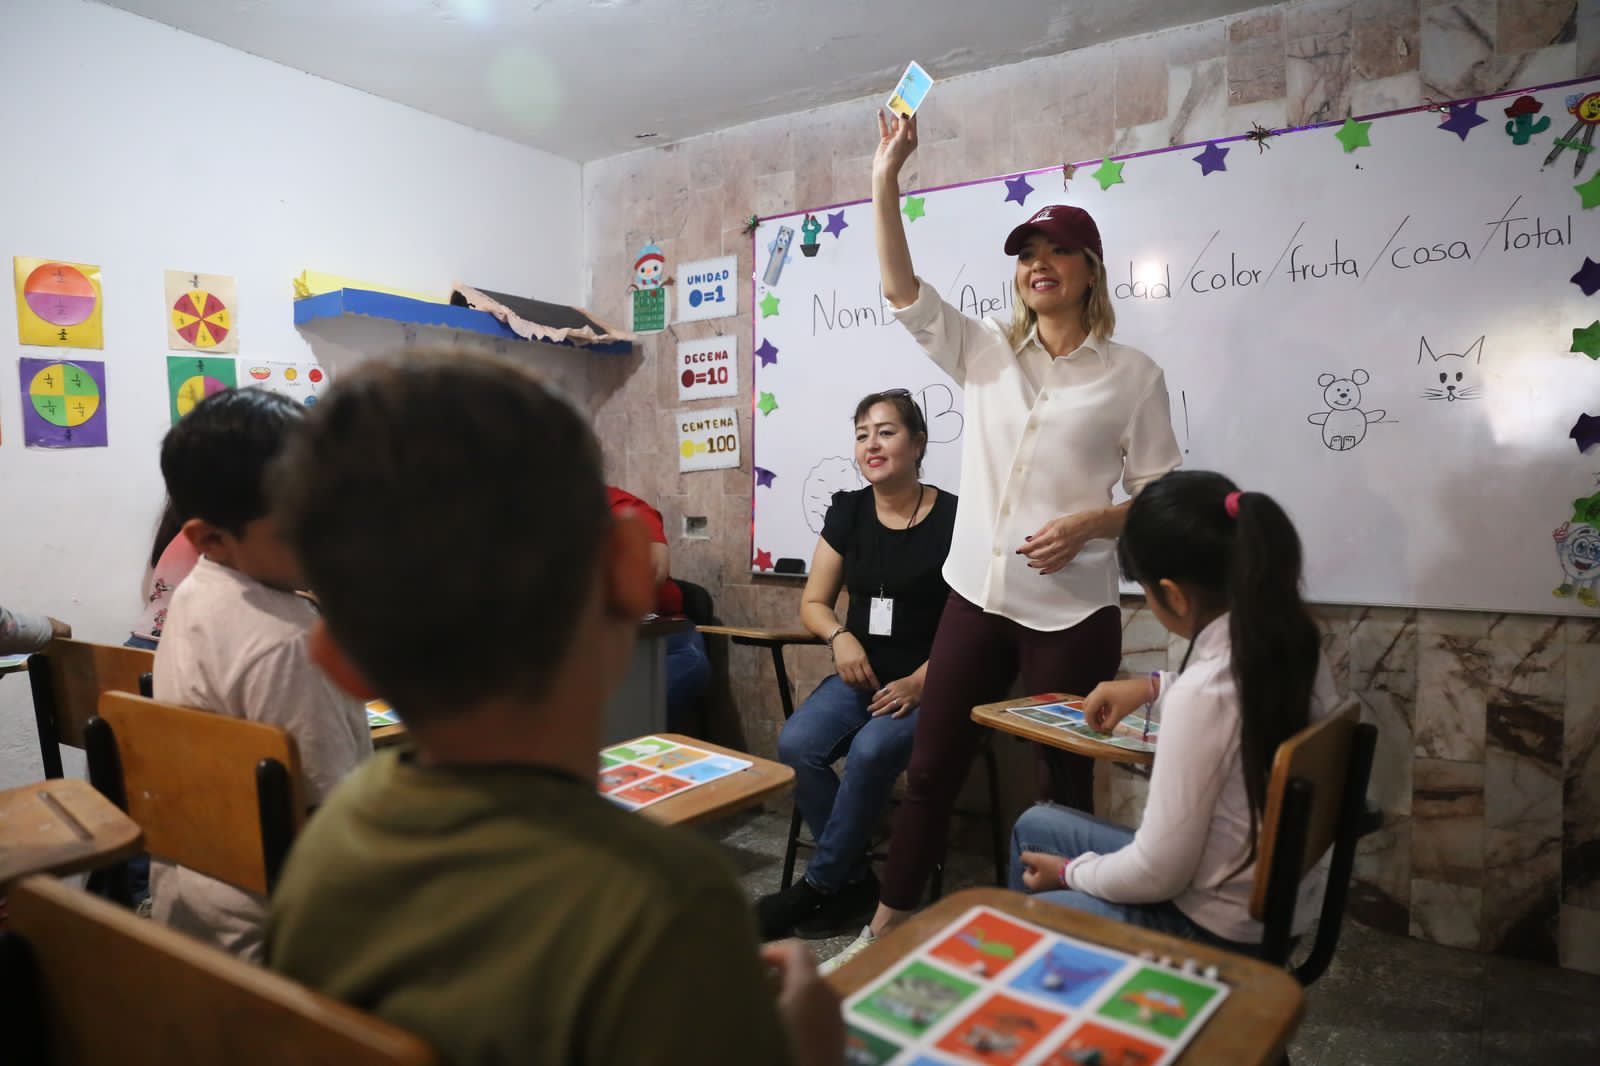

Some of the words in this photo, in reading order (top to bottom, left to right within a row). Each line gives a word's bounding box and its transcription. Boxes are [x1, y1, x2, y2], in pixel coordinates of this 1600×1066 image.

[687, 269, 729, 285] UNIDAD
[813, 280, 896, 336] Nomb
[960, 279, 1014, 320] Apell
[1115, 260, 1171, 299] dad
[1287, 239, 1359, 282] fruta
[1391, 241, 1471, 268] cosa
[1486, 216, 1571, 251] Total
[684, 350, 728, 365] DECENA
[682, 417, 734, 433] CENTENA
